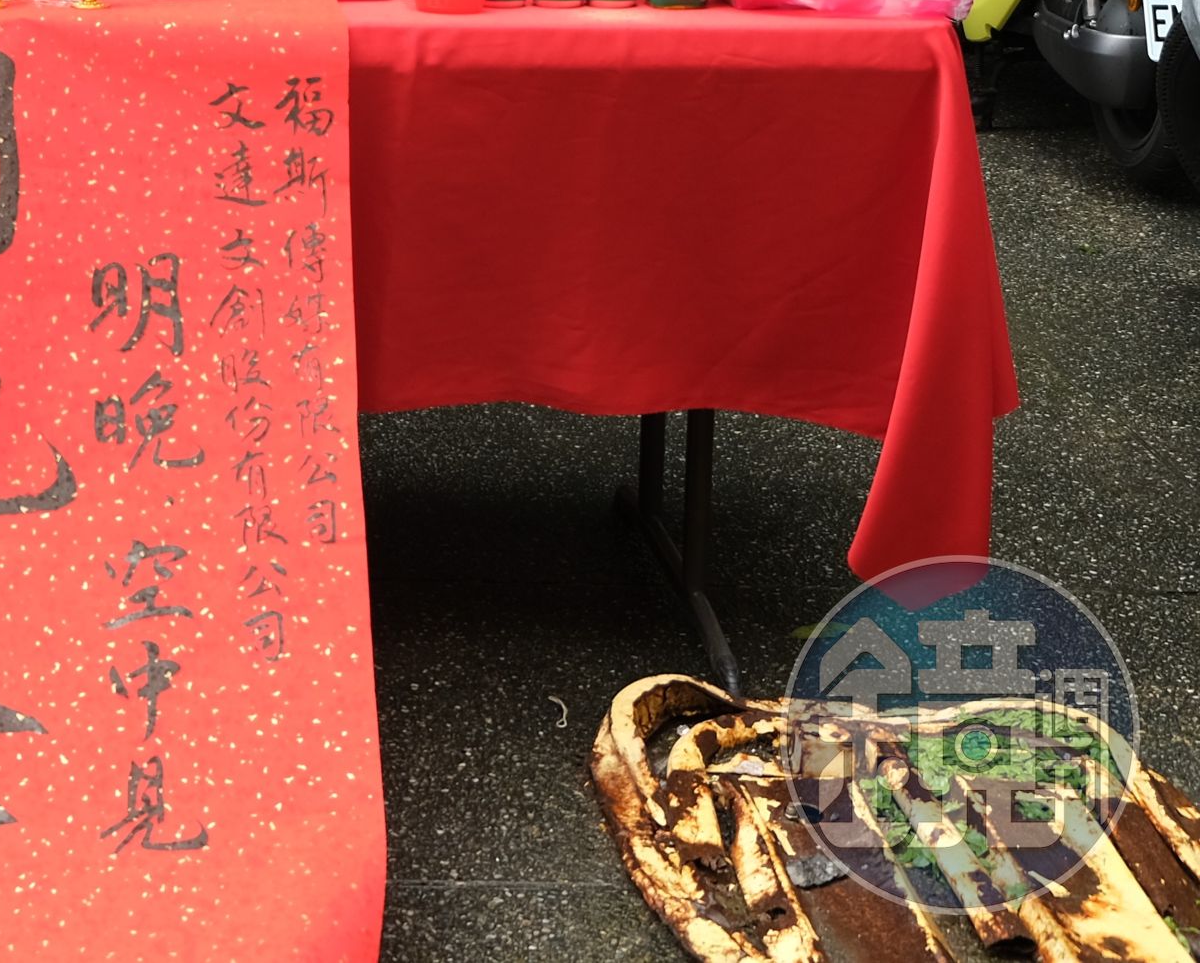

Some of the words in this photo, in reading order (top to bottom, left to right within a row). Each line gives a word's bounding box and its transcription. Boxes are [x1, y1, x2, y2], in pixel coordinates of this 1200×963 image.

[209, 83, 289, 663] 文達文創股份有限公司
[273, 76, 342, 545] 福斯傳媒有限公司
